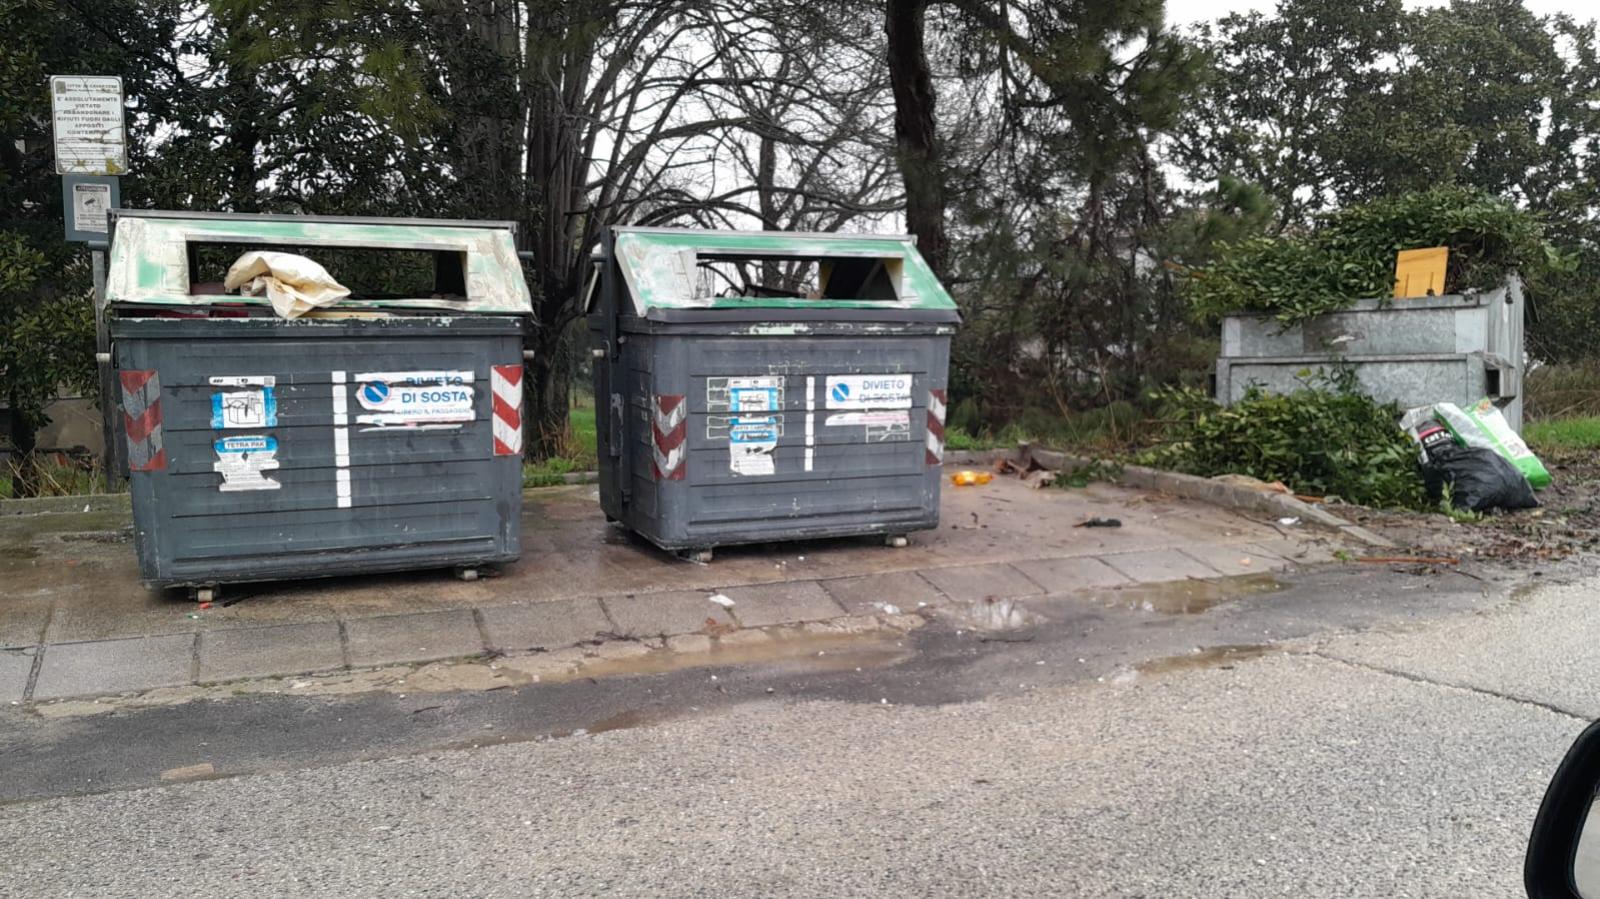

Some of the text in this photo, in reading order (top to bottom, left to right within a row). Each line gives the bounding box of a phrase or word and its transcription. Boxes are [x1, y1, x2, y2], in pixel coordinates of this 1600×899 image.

[862, 379, 905, 391] DIVIETO
[402, 391, 469, 403] DI SOSTA
[227, 441, 250, 449] TETRA
